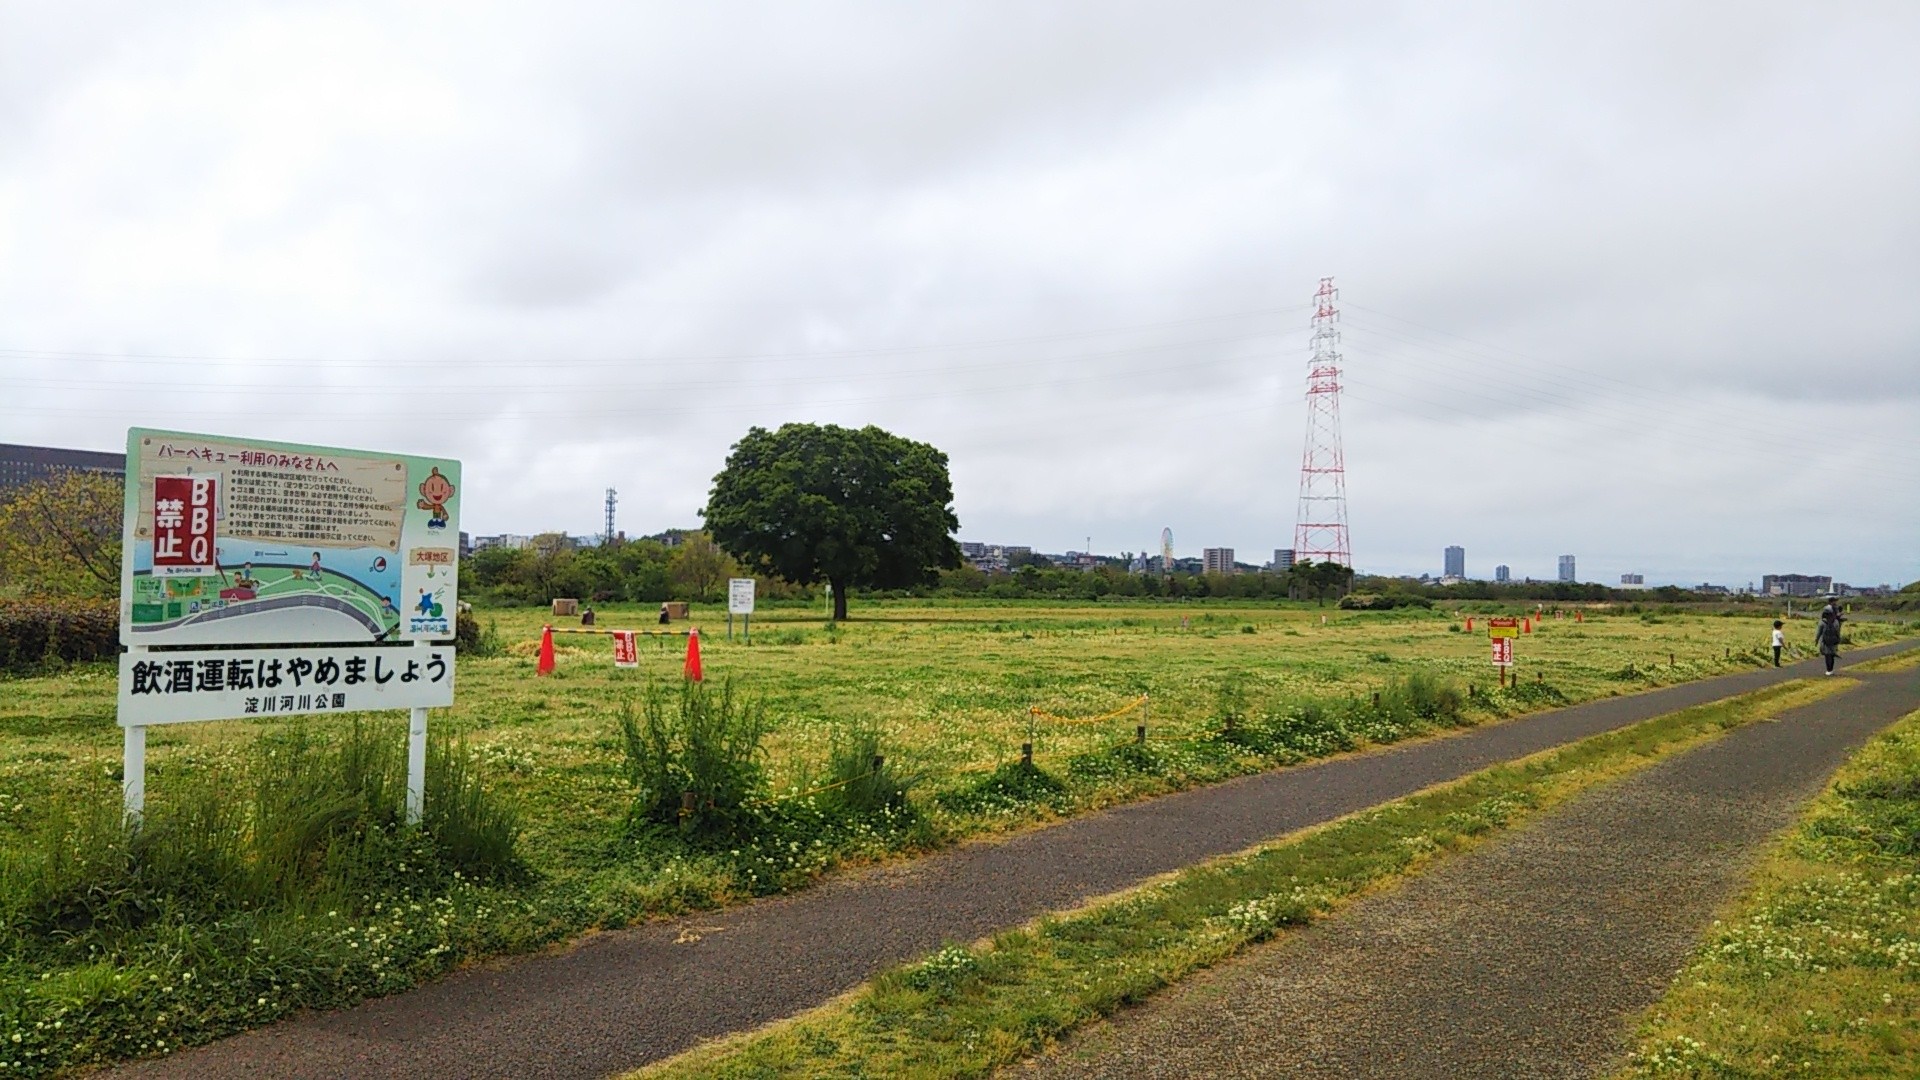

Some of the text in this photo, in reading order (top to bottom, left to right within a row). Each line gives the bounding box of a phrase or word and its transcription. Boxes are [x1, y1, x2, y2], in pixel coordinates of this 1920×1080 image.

[158, 444, 339, 471] バーベキュー利用のみなさんへ
[156, 498, 183, 559] 禁止
[191, 478, 208, 564] BBQ
[416, 551, 449, 562] 大塚地区
[131, 653, 447, 696] 飲酒運転はやめましょう
[244, 692, 346, 713] 淀川河川公園
